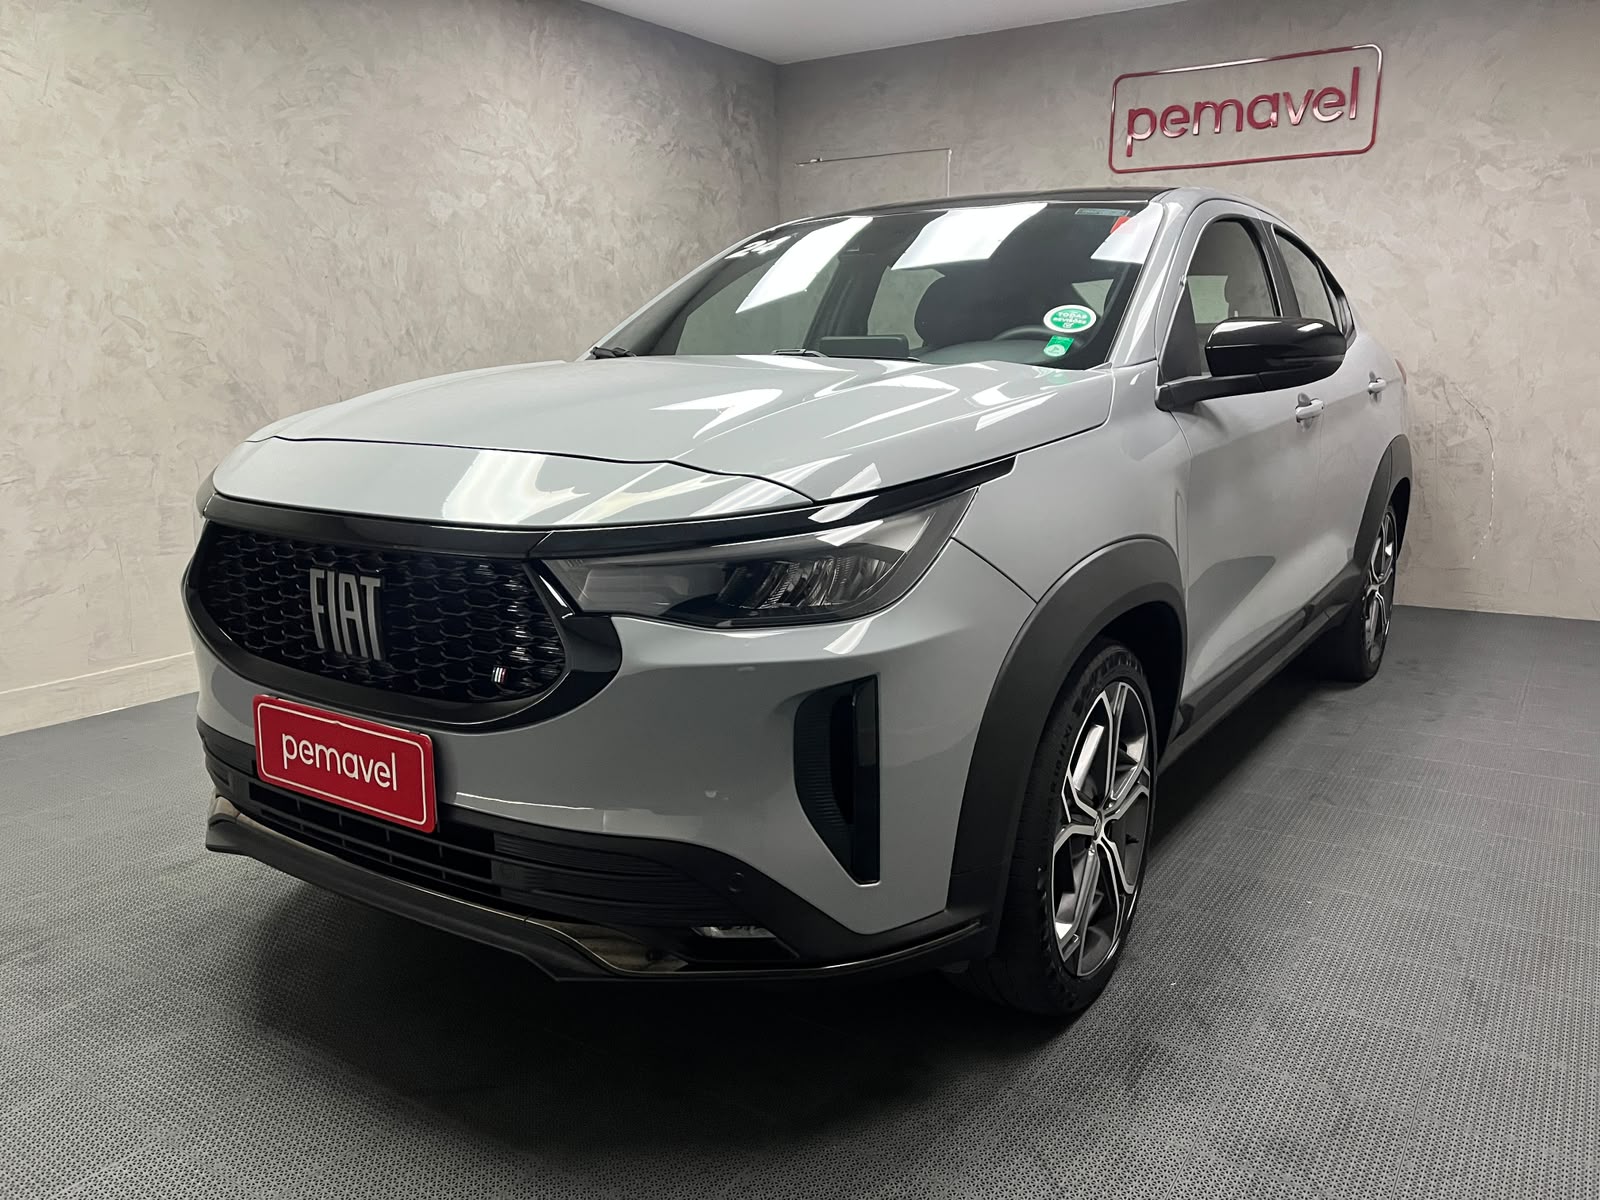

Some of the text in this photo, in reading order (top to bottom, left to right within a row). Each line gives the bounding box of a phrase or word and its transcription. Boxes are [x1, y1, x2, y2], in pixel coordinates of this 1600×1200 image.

[1126, 66, 1360, 158] pemavel
[309, 567, 382, 661] FIAT
[281, 733, 398, 792] pemavel
